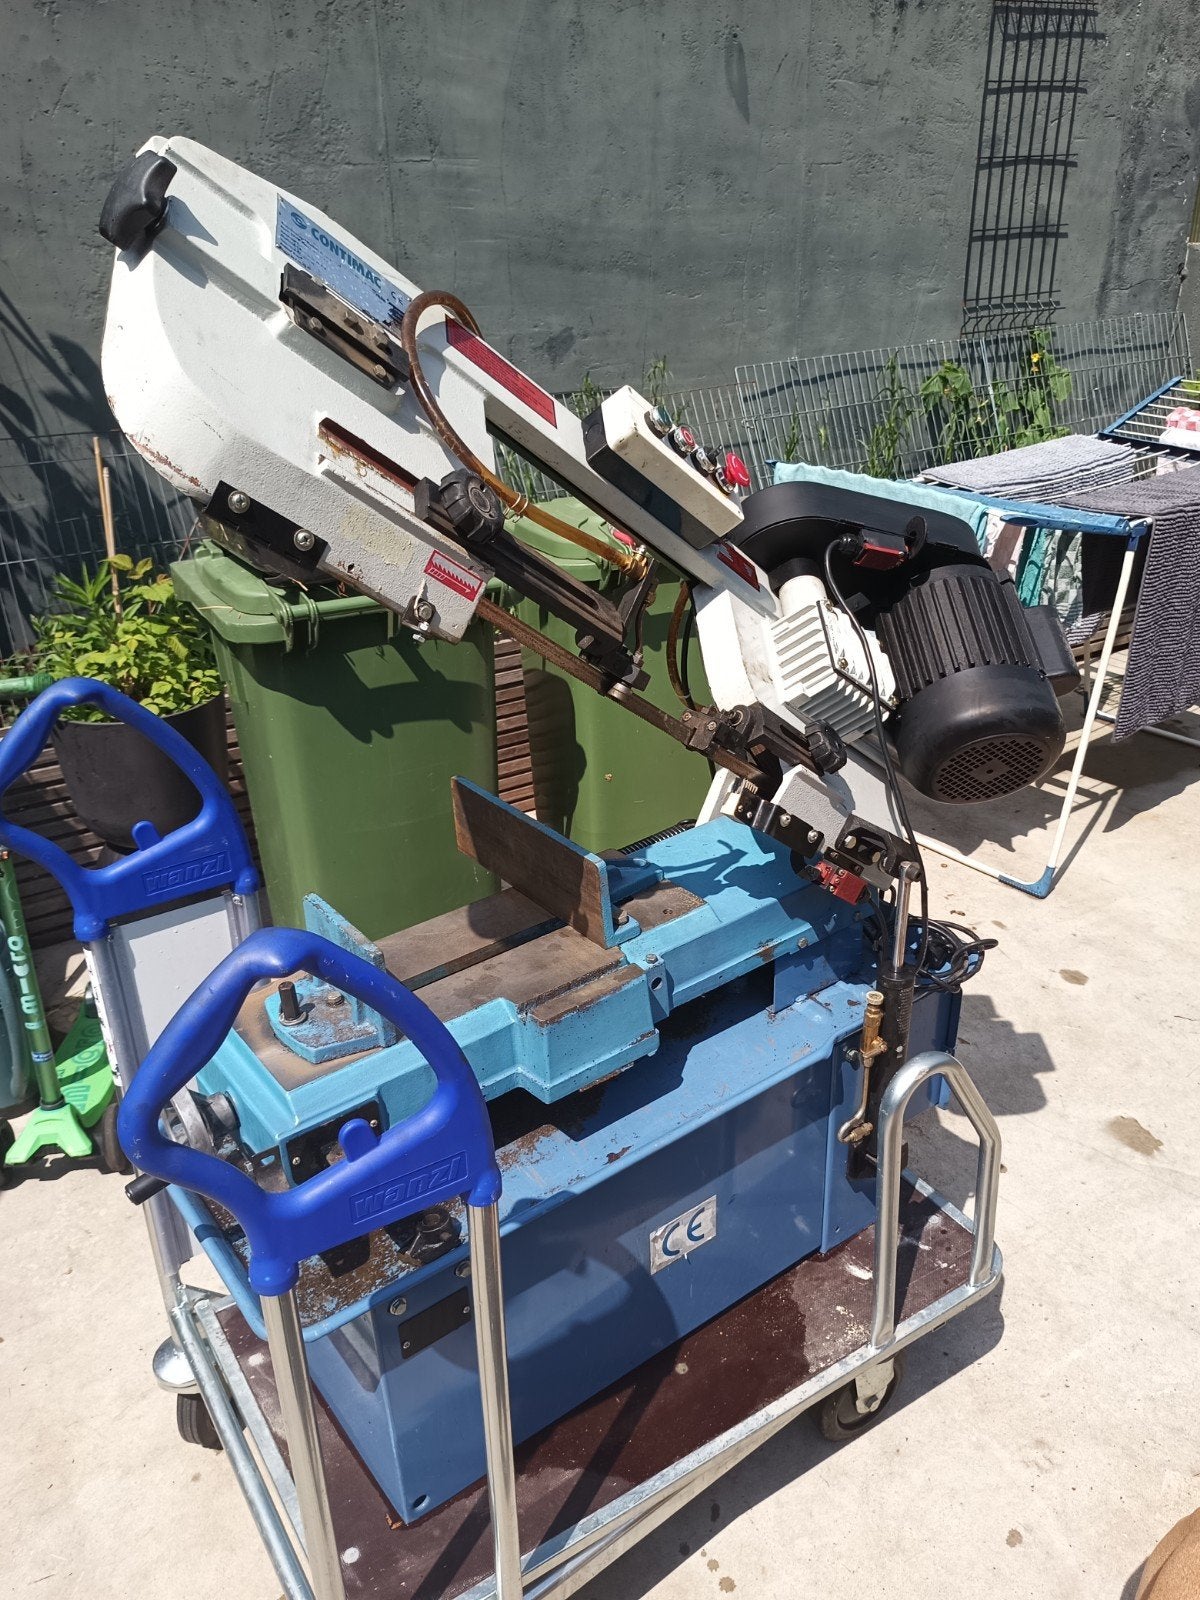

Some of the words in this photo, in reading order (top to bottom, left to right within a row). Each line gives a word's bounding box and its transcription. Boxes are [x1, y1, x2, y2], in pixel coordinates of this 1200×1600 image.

[310, 227, 382, 290] CONTIMAC
[146, 854, 224, 893] wanzl
[354, 1156, 461, 1219] wanzl
[662, 1206, 705, 1256] CE
